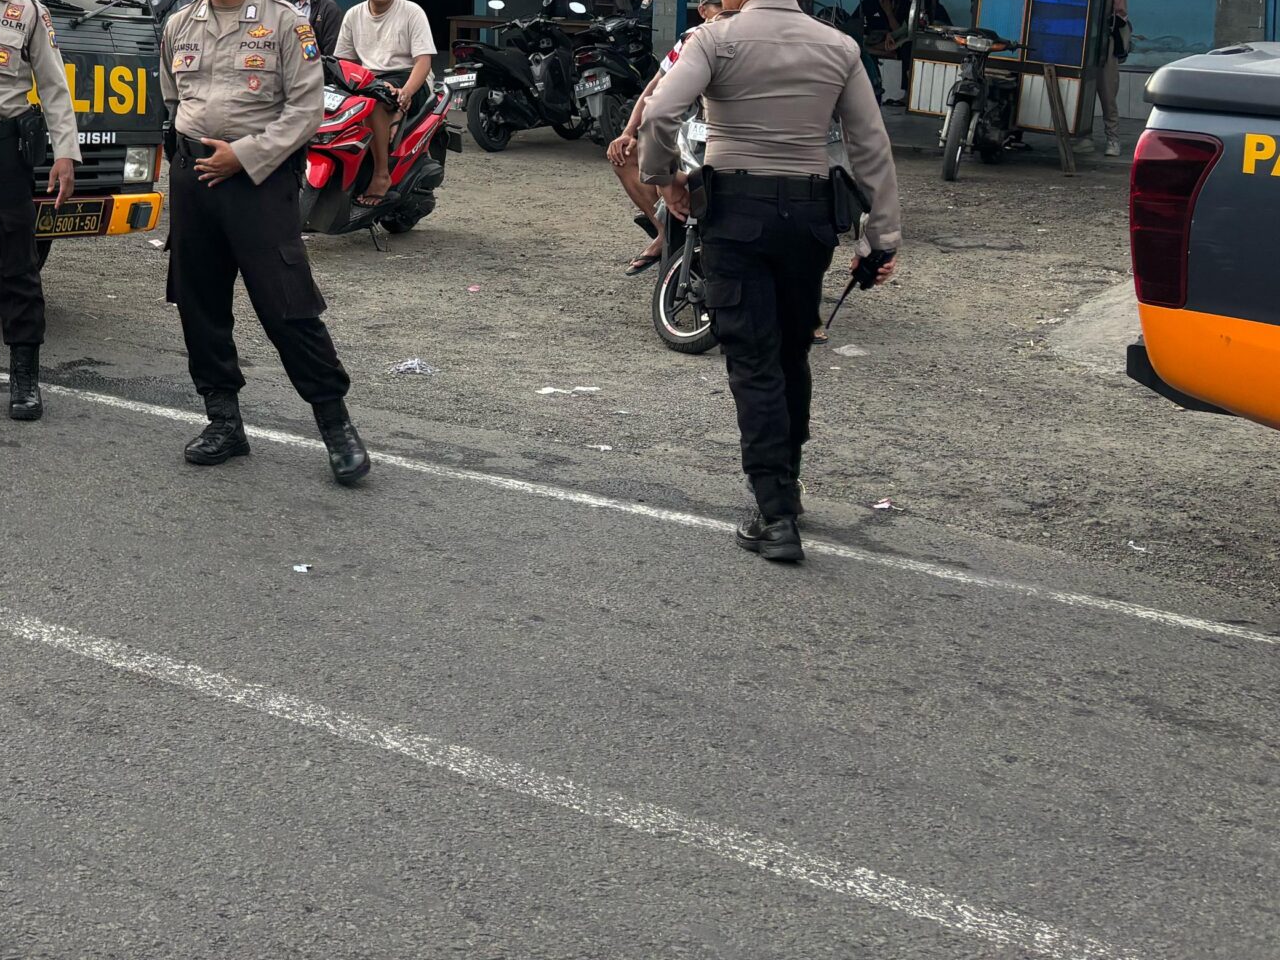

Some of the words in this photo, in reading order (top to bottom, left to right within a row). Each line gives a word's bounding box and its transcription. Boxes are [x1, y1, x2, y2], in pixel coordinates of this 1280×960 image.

[240, 41, 276, 50] POLRI
[76, 203, 83, 213] X
[55, 216, 97, 232] 5001-50
